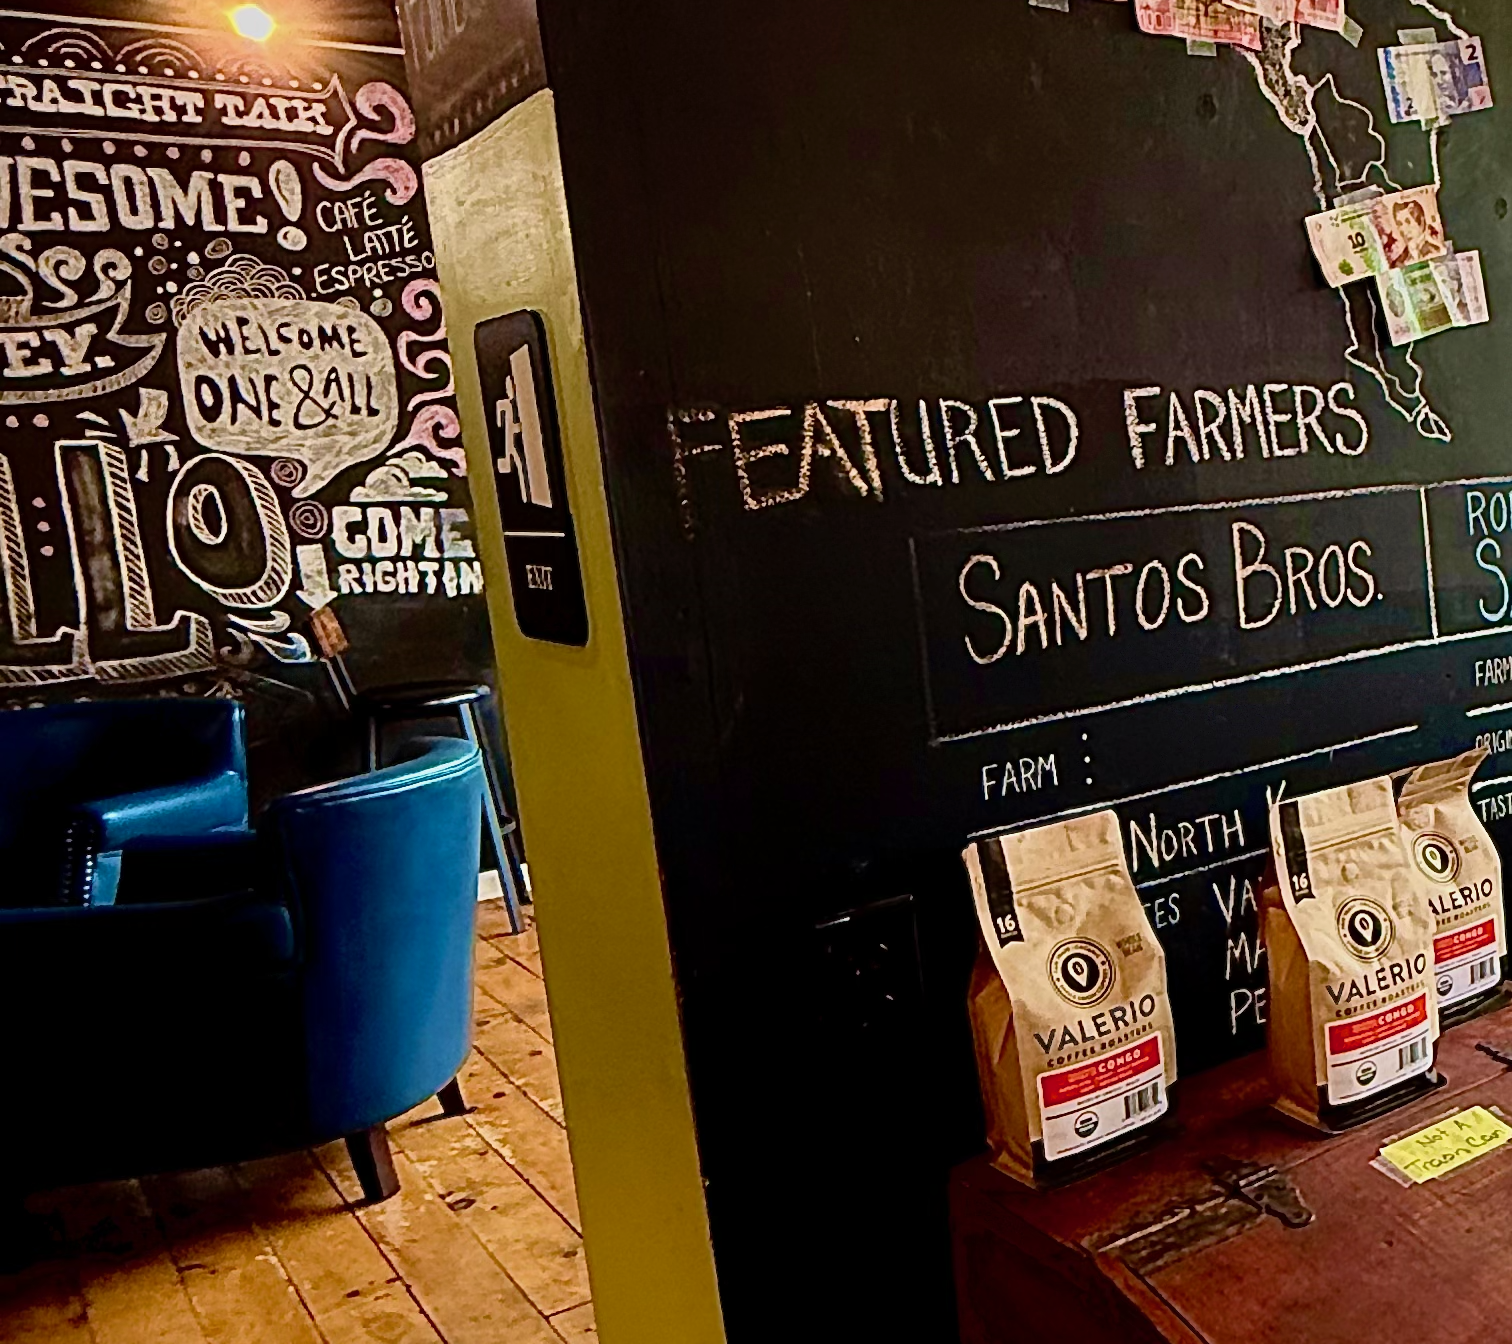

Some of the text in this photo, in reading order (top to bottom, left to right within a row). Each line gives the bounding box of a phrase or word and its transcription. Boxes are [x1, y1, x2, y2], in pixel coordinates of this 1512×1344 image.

[1464, 43, 1478, 62] 2
[0, 75, 335, 136] RAIGHT TALK
[0, 155, 308, 251] ESOME!
[316, 190, 384, 233] CAFÉ
[313, 251, 437, 295] ESPRESSO
[198, 316, 369, 359] WELCOME
[193, 373, 283, 428] ONE
[323, 366, 381, 418] ALL
[667, 382, 1369, 540] FEATURED FARMERS
[331, 505, 476, 559] COME
[337, 560, 484, 598] RIGHT IN
[525, 564, 553, 591] EXIT
[958, 521, 1384, 665] SANTOS BROS.
[1129, 808, 1245, 873] NORTH
[1291, 873, 1309, 894] 16
[1428, 877, 1494, 915] ALERIO
[995, 912, 1017, 935] 16
[1325, 952, 1427, 1006] VALERIO
[1033, 993, 1157, 1055] VALERIO
[1046, 1023, 1154, 1069] COFFEE ROASTERS
[1097, 1047, 1142, 1073] CONGO
[1415, 1126, 1450, 1149] Not
